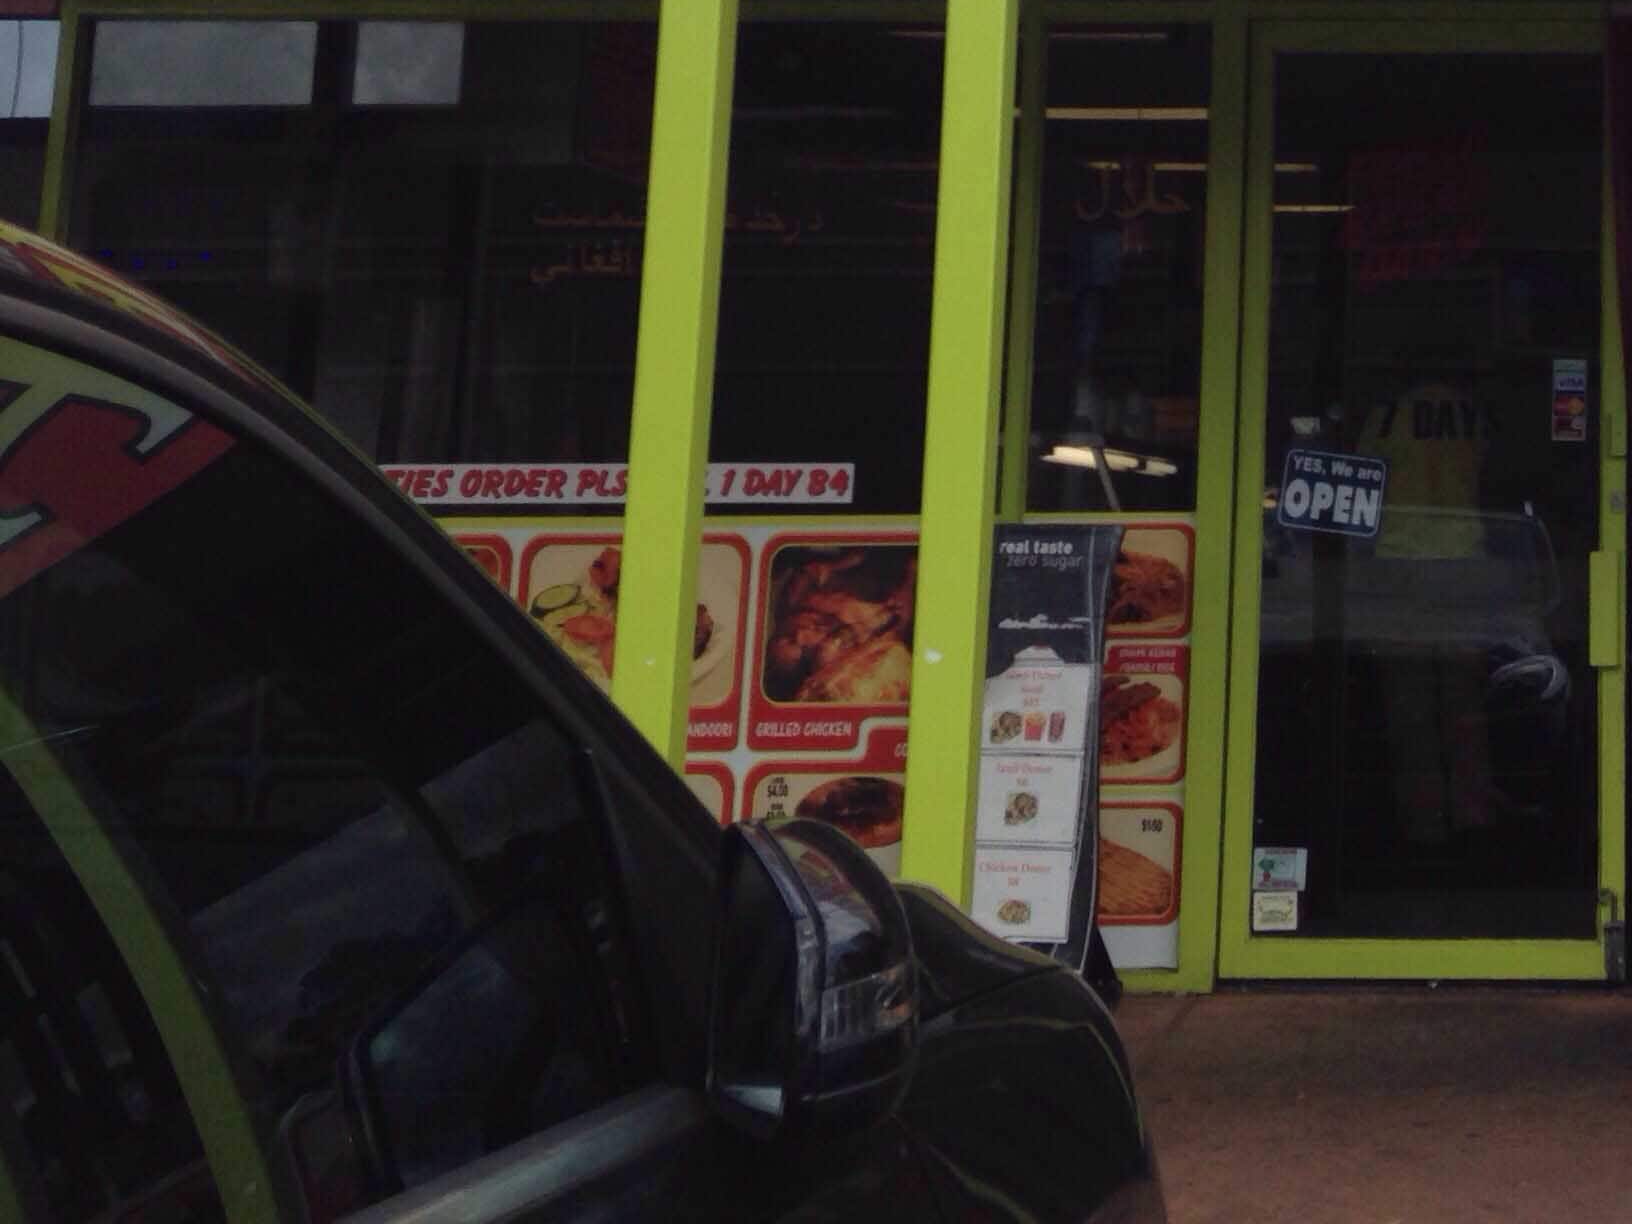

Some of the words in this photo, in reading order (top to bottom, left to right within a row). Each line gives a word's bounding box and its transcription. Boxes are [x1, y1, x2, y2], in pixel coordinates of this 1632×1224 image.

[1330, 460, 1354, 479] We
[1357, 466, 1382, 482] are
[459, 468, 567, 500] ORDER
[743, 468, 803, 497] DAY
[1284, 477, 1380, 527] OPEN
[999, 539, 1030, 554] real
[1032, 539, 1074, 555] taste
[1007, 554, 1039, 568] zero
[1041, 555, 1083, 572] sugar
[755, 722, 801, 737] GRILLED
[803, 722, 853, 737] CHICKEN
